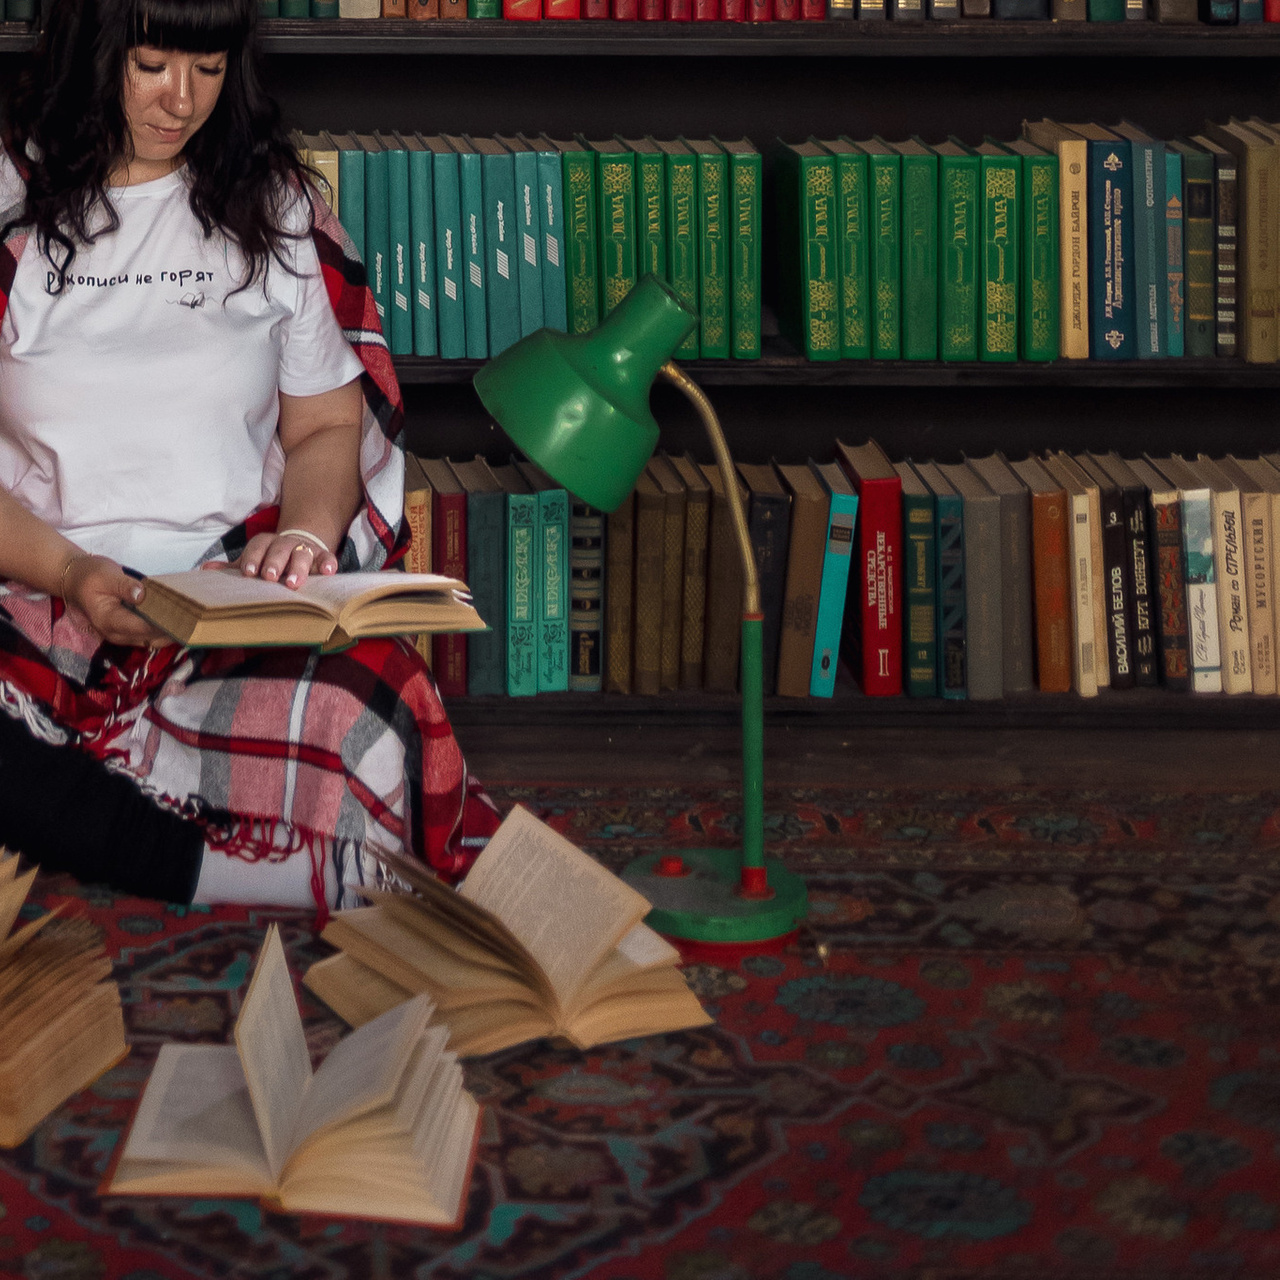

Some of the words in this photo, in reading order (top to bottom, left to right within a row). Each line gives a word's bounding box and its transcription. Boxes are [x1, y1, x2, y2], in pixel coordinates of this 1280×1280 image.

[1070, 190, 1081, 232] БАЙРОН
[135, 273, 153, 285] не
[1071, 237, 1081, 278] ГОРДОН
[1221, 509, 1238, 576] СТРЕЛЬБОЙ
[1251, 517, 1267, 609] МУСОРГСКИЙ
[1110, 566, 1124, 610] БЕЛОВ
[1133, 538, 1147, 595] ВОННЕГУТ
[1136, 600, 1149, 630] КУРТ
[1114, 612, 1129, 675] ВАСИЛИЙ
